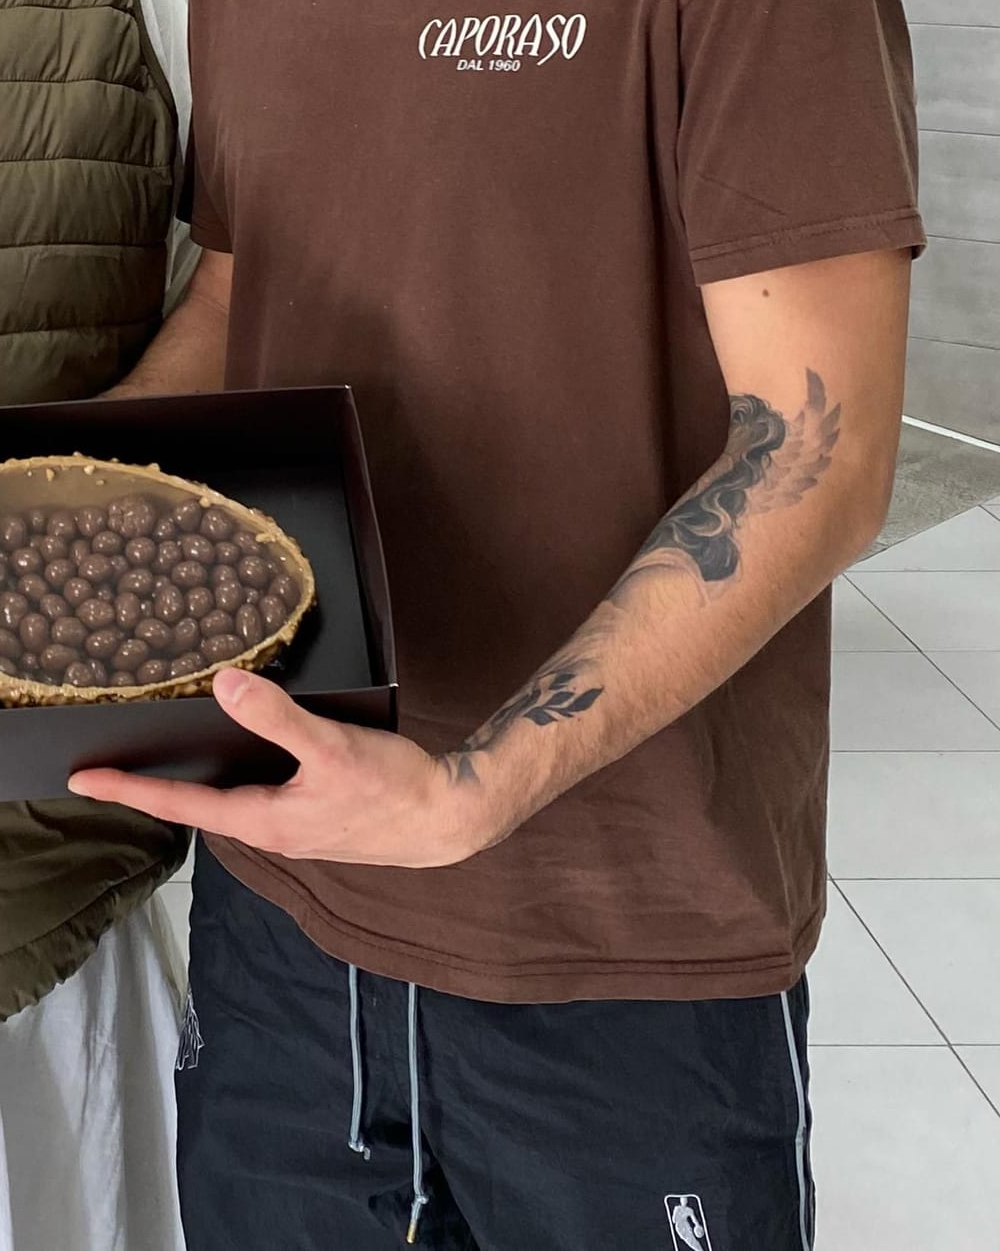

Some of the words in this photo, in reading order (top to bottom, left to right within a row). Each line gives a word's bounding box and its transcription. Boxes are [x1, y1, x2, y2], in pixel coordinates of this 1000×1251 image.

[418, 13, 587, 66] CAPORASO
[456, 59, 484, 71] DAL
[488, 59, 521, 72] 1960
